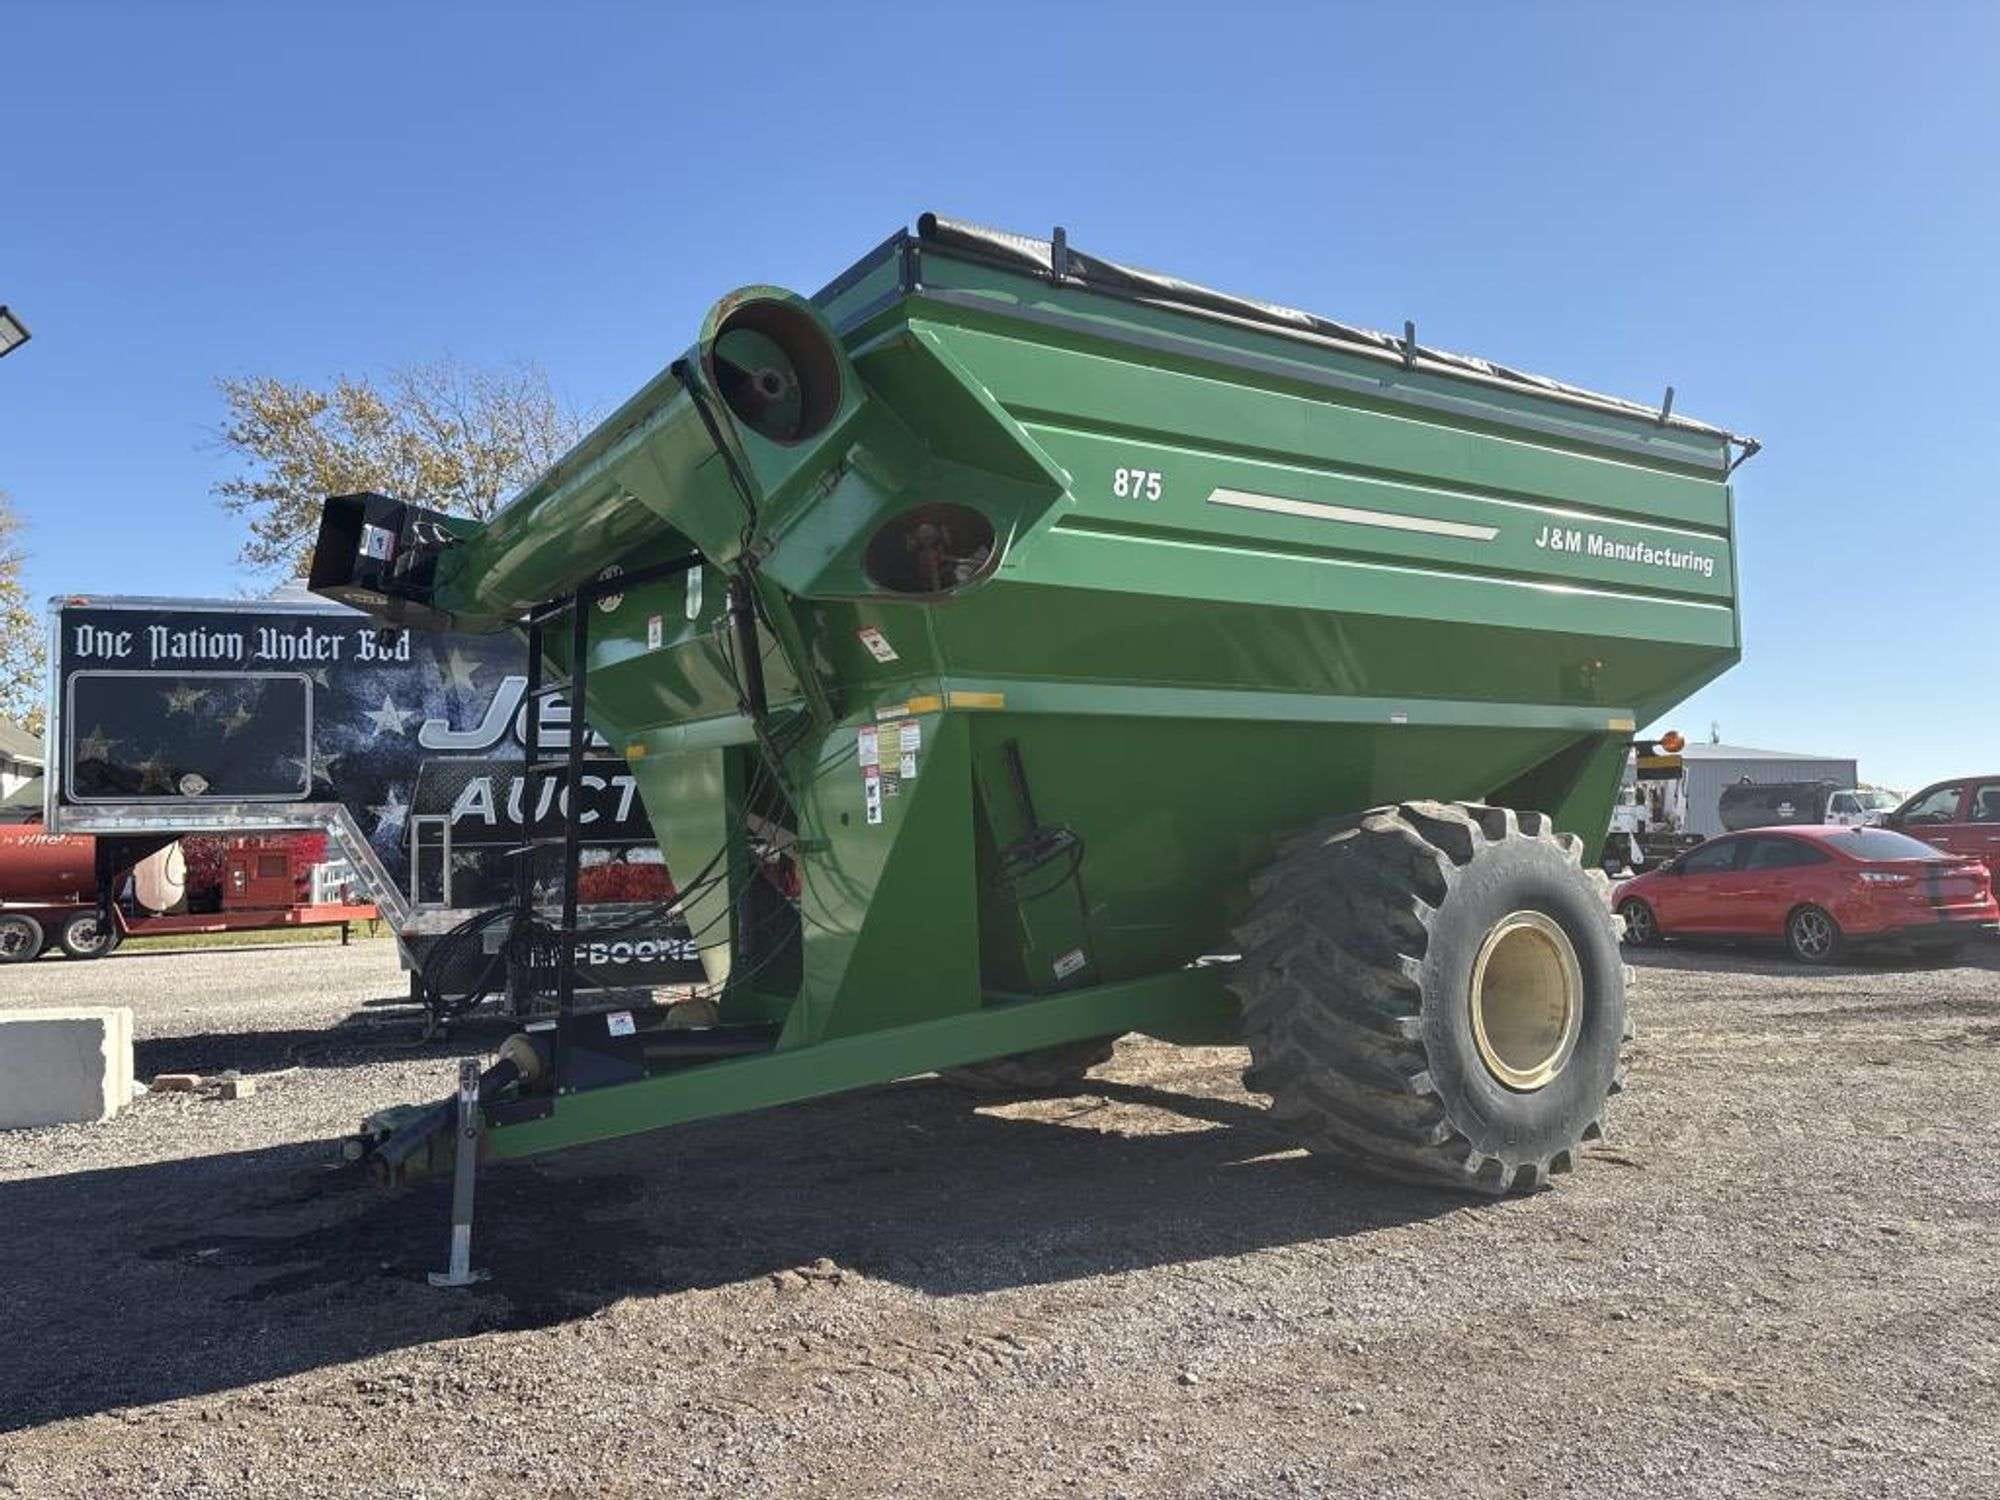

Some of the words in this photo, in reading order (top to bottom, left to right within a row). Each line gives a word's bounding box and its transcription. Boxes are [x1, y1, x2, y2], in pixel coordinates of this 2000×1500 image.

[1113, 468, 1162, 501] 875
[1535, 526, 1582, 553] J&M
[1587, 533, 1715, 578] Manufacturing
[75, 624, 133, 660] One
[144, 625, 243, 663] Nation
[253, 627, 345, 662] Under
